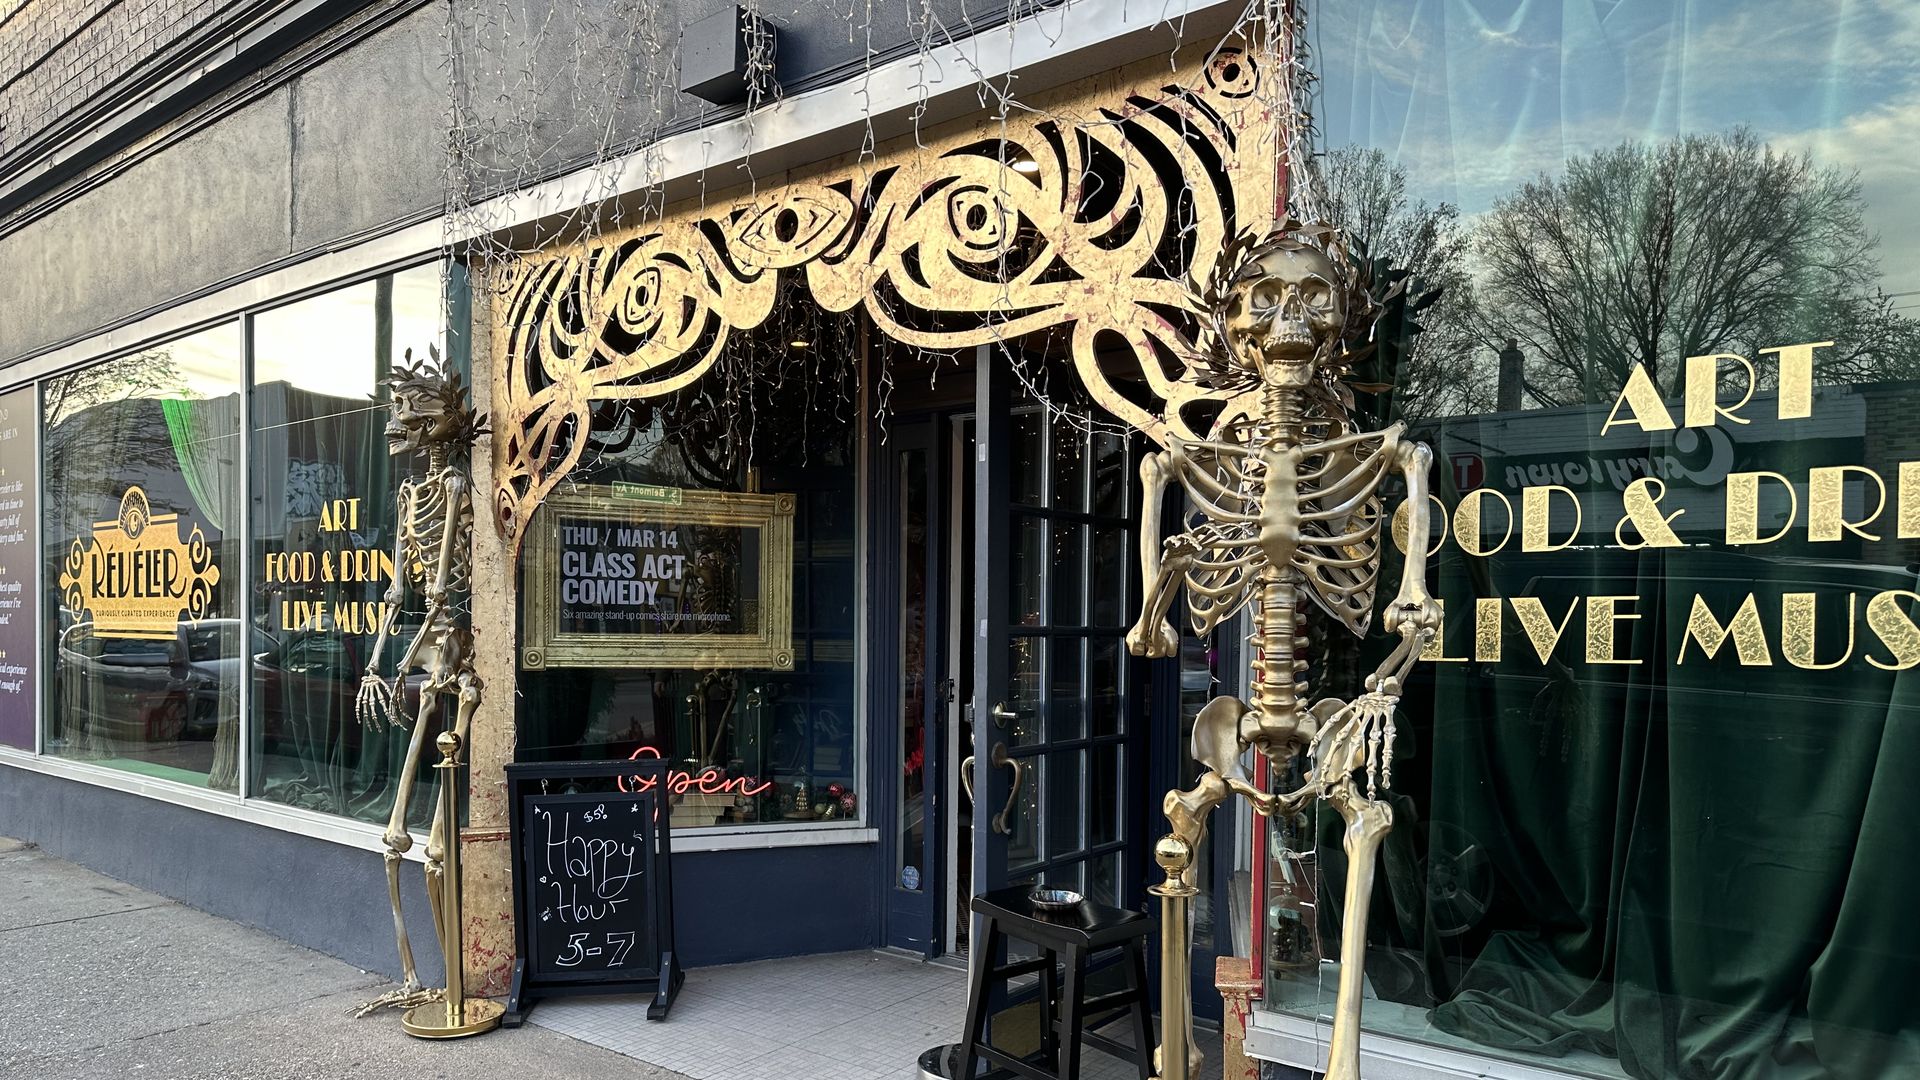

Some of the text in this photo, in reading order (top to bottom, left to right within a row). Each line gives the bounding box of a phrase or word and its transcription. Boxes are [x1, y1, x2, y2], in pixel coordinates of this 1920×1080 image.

[1600, 341, 1834, 436] ART
[318, 498, 361, 532] ART
[1615, 477, 1685, 551] &
[563, 526, 678, 549] THU / MAR 14
[266, 549, 424, 583] FOOD & DRIN
[562, 551, 685, 579] CLASS ACT
[562, 578, 659, 606] COMEDY
[96, 609, 175, 617] CURIOUSLY CURATED EXPERIENCES
[282, 600, 328, 633] LIVE
[563, 609, 575, 619] Six
[576, 609, 604, 622] amazing
[605, 610, 635, 622] stand-up
[635, 611, 660, 621] comics
[660, 611, 679, 621] share
[679, 612, 692, 621] one
[542, 811, 644, 899] Happy
[550, 881, 629, 923] Hour
[555, 931, 636, 967] 5-7
